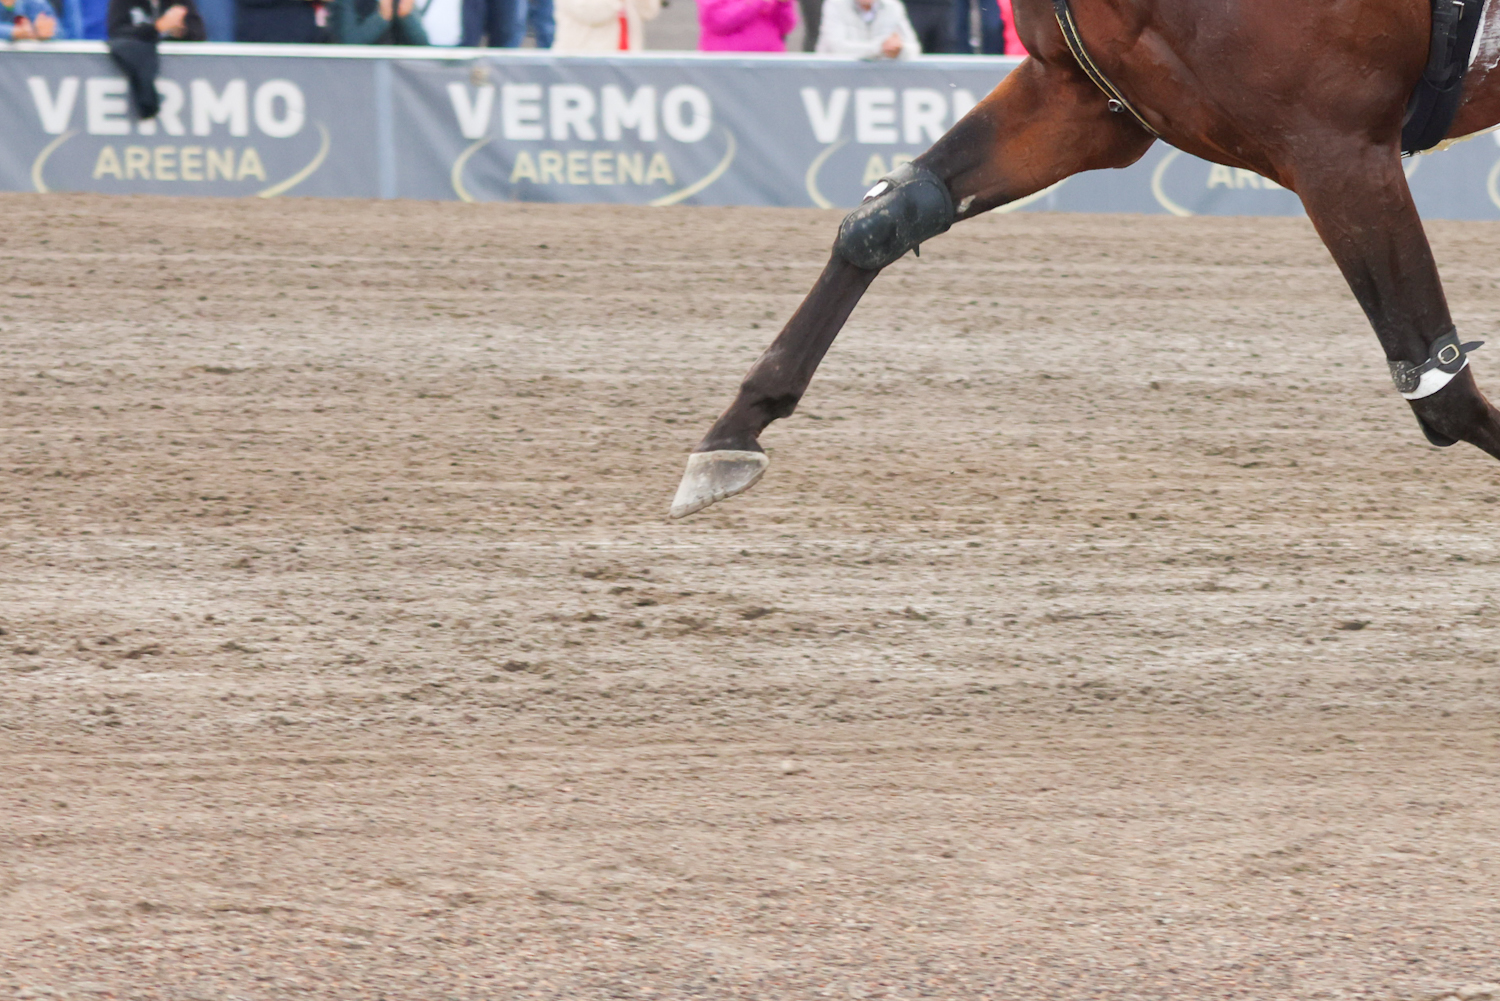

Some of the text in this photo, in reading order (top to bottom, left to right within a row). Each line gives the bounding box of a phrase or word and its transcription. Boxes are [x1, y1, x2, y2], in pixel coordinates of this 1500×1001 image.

[27, 76, 306, 138] VERMO
[445, 82, 713, 143] VERMO
[800, 86, 979, 144] VER
[92, 145, 267, 182] AREENA
[509, 151, 675, 185] AREENA
